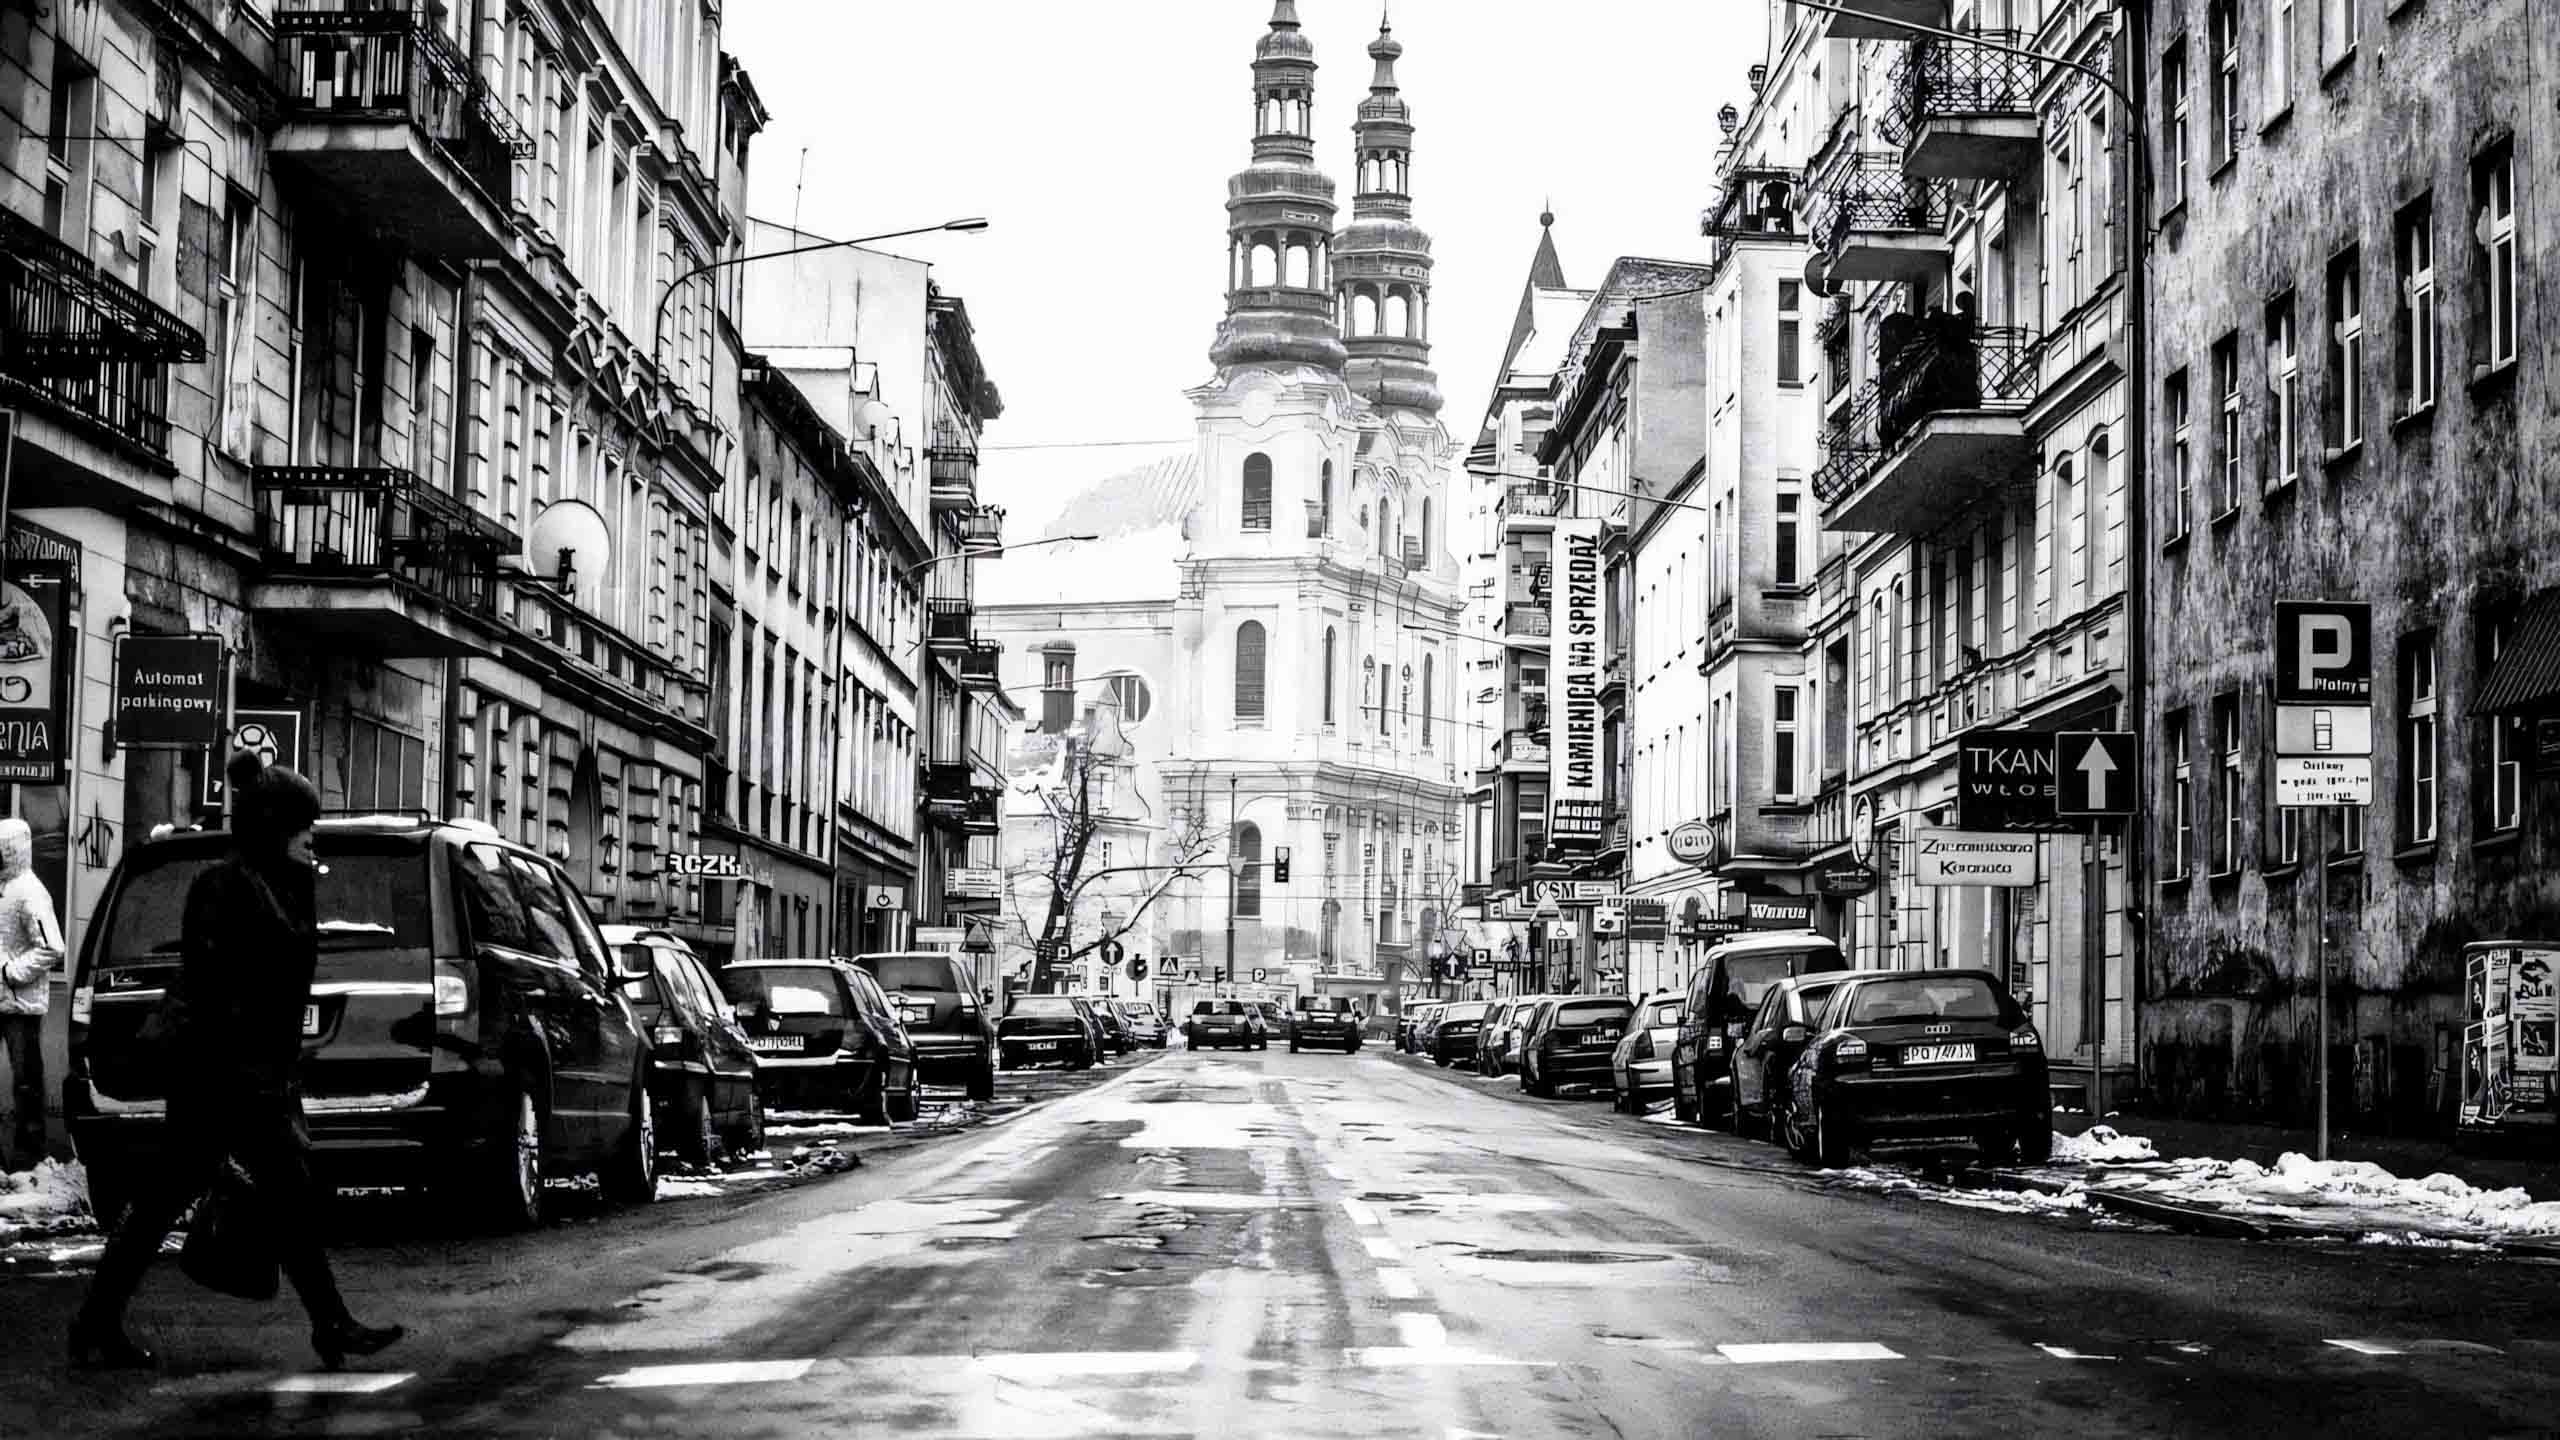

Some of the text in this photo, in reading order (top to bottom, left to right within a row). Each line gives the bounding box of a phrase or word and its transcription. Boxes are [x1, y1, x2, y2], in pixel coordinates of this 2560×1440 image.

[1564, 533, 1597, 636] SPRZEDAŻ
[1568, 641, 1596, 667] NA
[2298, 614, 2352, 690] P
[135, 668, 204, 686] Automat
[121, 692, 213, 713] parkingowy
[1567, 672, 1596, 788] KAMIENICA
[1966, 748, 2054, 775] TKAN
